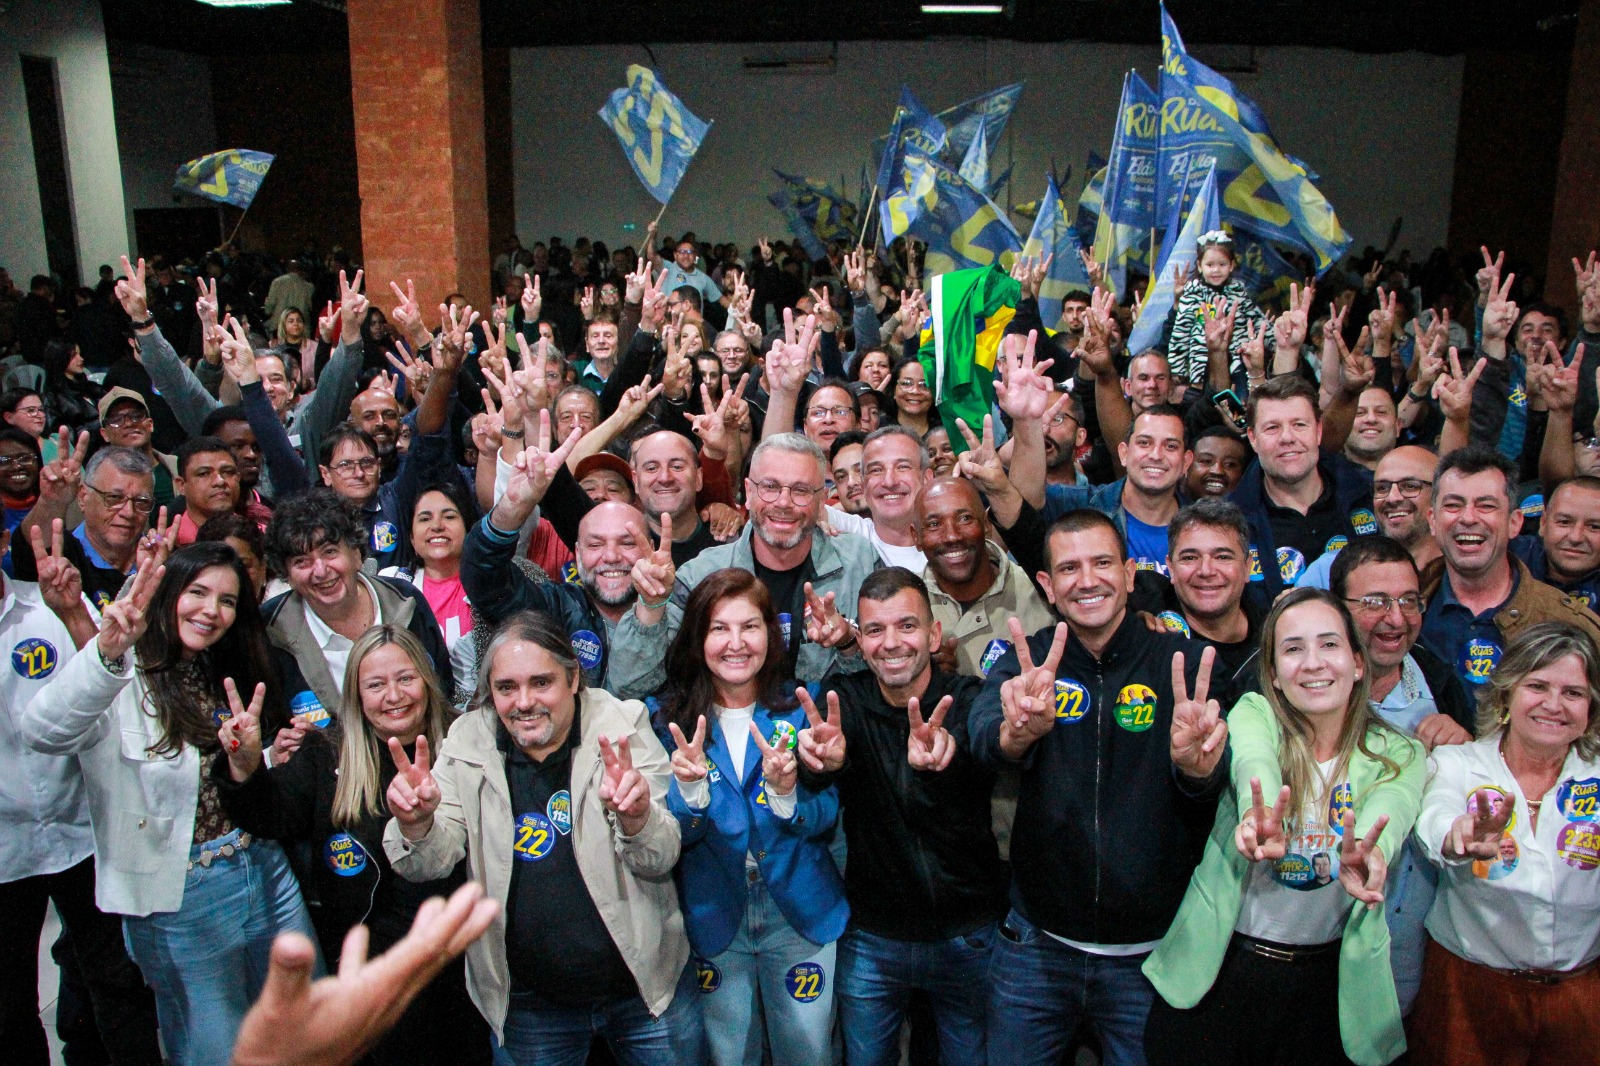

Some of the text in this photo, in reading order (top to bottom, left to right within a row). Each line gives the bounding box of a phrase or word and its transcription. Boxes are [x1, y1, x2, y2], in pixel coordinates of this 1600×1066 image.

[1125, 103, 1156, 138] Ru
[1161, 97, 1224, 136] Rua
[1509, 389, 1527, 405] 22
[1136, 562, 1155, 570] Ruas
[572, 640, 599, 655] DRABLE
[1470, 645, 1494, 656] Ruas
[22, 646, 54, 677] 22
[1473, 659, 1492, 676] 22
[1056, 691, 1083, 717] 22
[1133, 705, 1154, 725] 22
[1572, 784, 1598, 797] Ruas
[1575, 797, 1596, 817] 22
[1576, 825, 1594, 834] VOTE
[331, 840, 353, 853] Ruas
[514, 826, 548, 856] 22
[338, 852, 357, 869] 22
[1280, 872, 1307, 881] 11212
[697, 970, 714, 989] 2
[794, 974, 819, 997] 22
